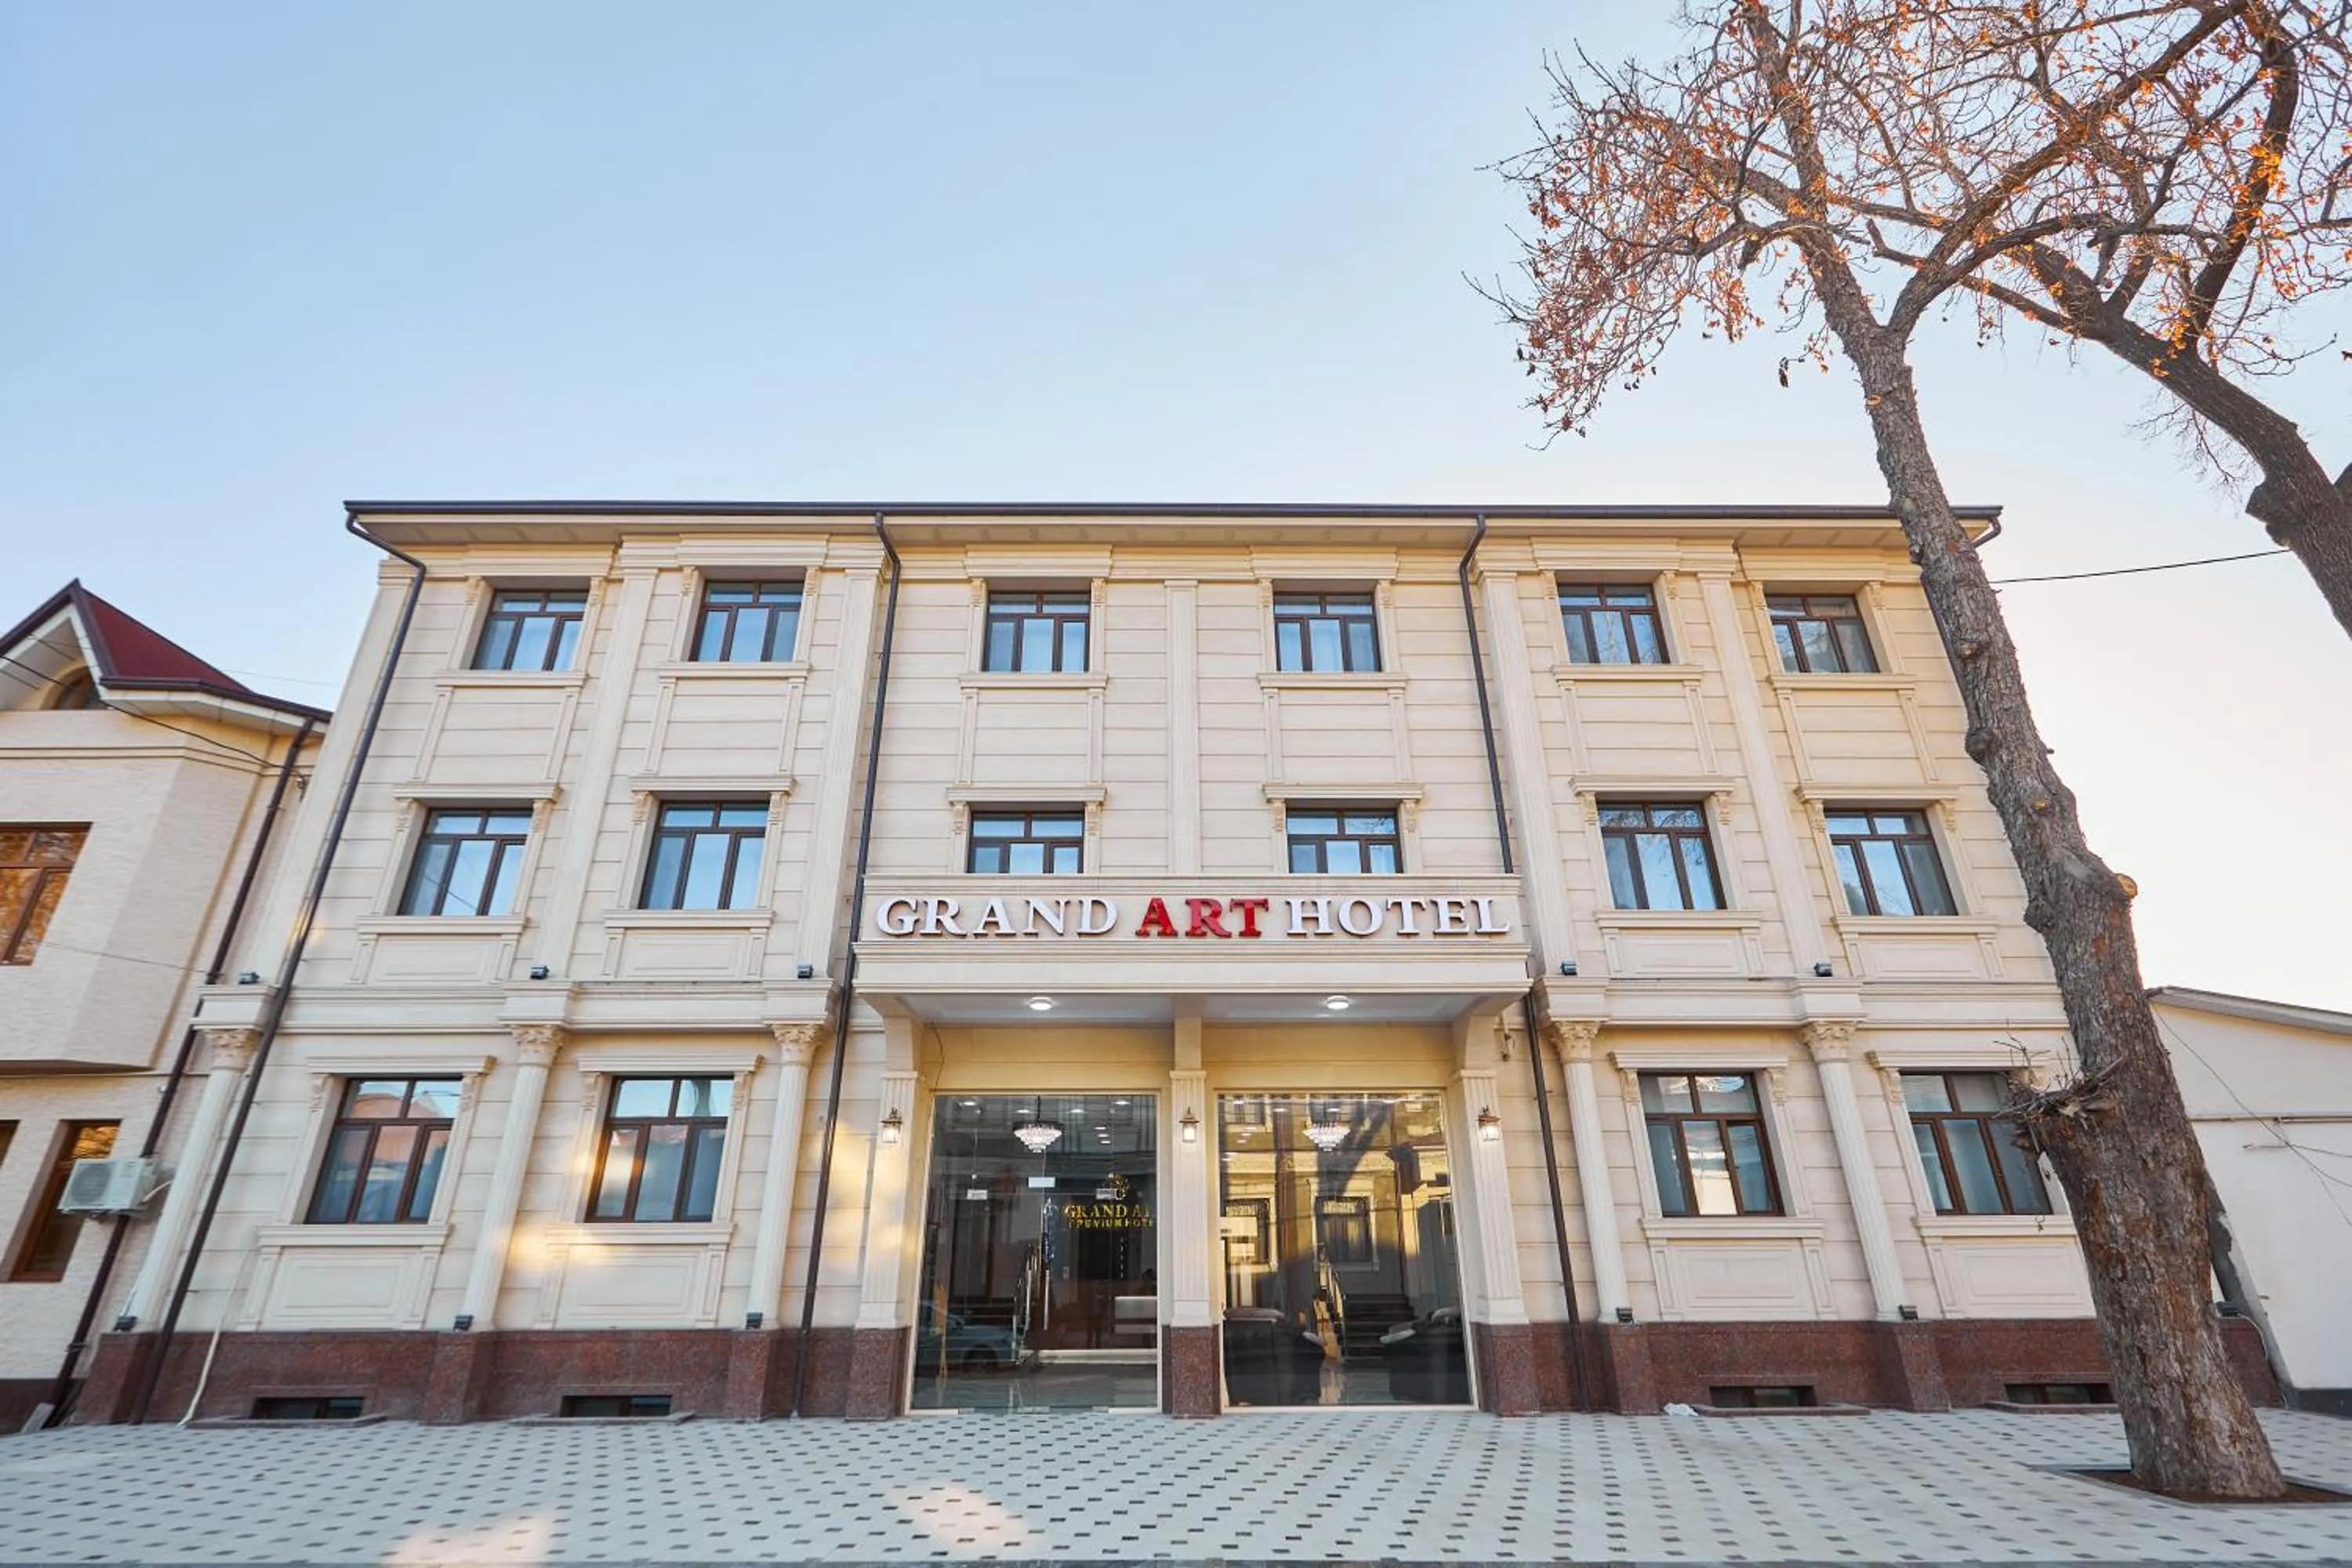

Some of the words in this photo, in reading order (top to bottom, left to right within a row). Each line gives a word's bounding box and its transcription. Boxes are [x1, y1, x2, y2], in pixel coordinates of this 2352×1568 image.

[876, 898, 1119, 937] GRAND
[1135, 897, 1270, 938] ART
[1286, 898, 1511, 936] HOTEL
[1065, 1204, 1127, 1218] GRAND
